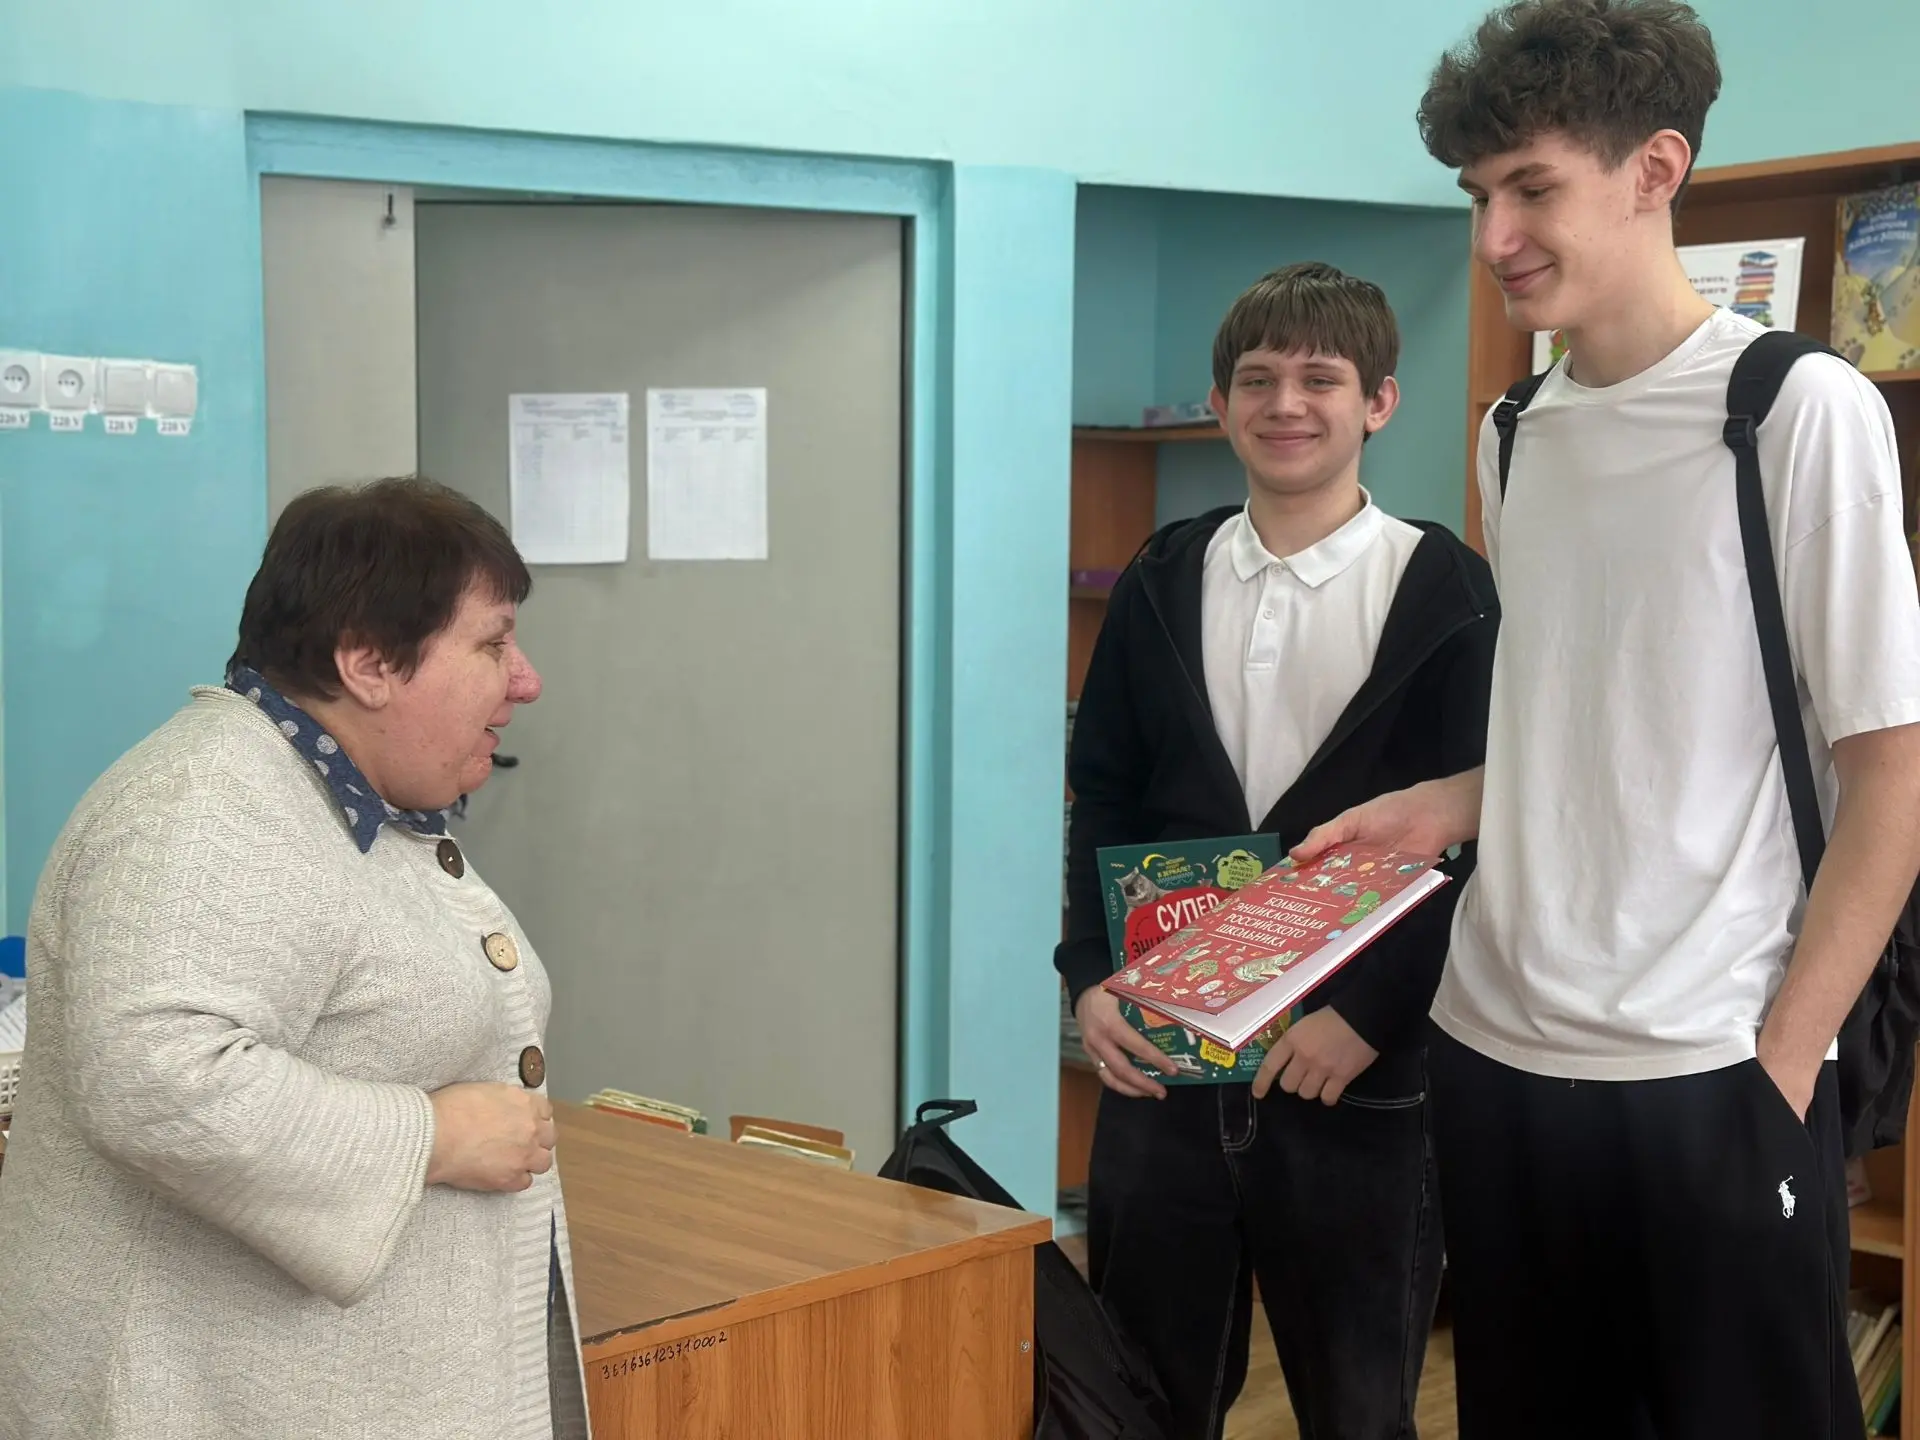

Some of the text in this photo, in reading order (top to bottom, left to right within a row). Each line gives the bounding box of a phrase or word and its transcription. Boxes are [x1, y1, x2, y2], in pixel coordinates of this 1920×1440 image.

[20, 412, 28, 424] V
[72, 416, 80, 426] V
[128, 420, 135, 431] V
[180, 421, 188, 432] V
[1264, 897, 1322, 915] БОЛЬШАЯ
[1232, 902, 1329, 930] ЭНЦИКЛОПЕДИЯ
[1224, 913, 1307, 938] РОССИЙСКОГО
[1216, 924, 1287, 948] ШКОЛЬНИКА
